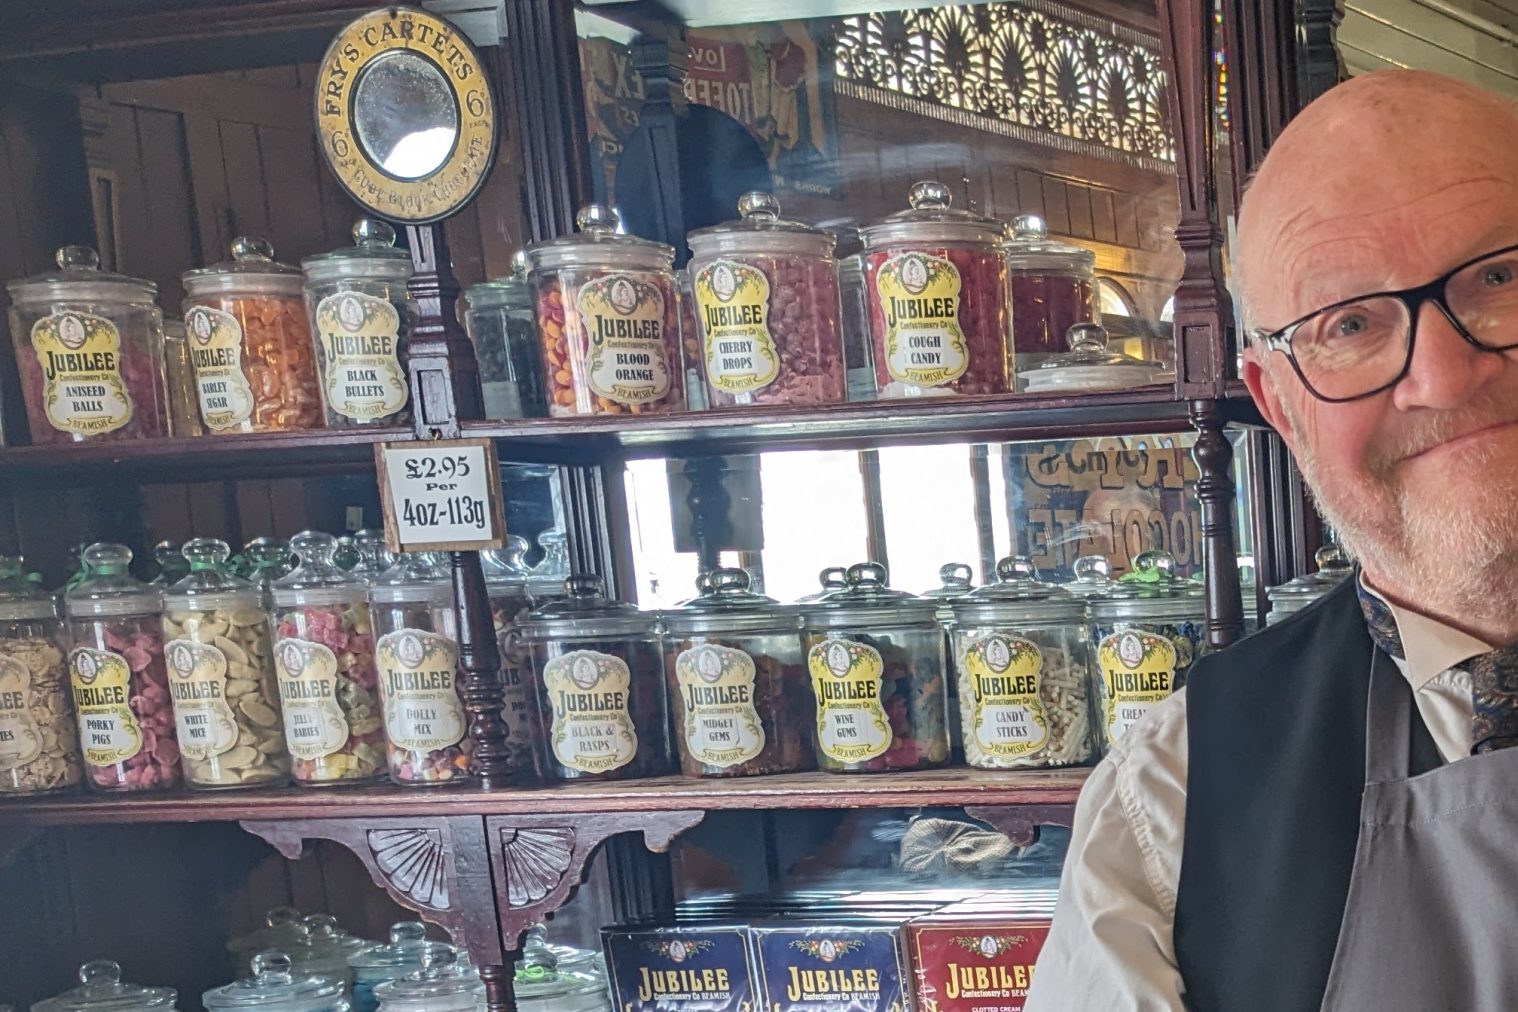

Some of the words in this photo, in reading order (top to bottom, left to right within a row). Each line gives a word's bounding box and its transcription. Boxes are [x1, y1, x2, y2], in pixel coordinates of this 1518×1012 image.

[326, 43, 360, 117] FRY'S
[364, 21, 473, 80] CARTETS
[888, 297, 955, 328] JUBILEE
[705, 304, 762, 336] JUBILEE
[592, 314, 660, 345] JUBILEE
[328, 333, 392, 362] JUBILEE
[719, 341, 753, 353] CHERRY
[909, 336, 941, 348] COUGH
[616, 353, 650, 365] BLOOD
[723, 357, 753, 370] DROPS
[910, 352, 941, 364] CANDY
[46, 351, 116, 380] JUBILEE
[347, 370, 377, 381] BLACK
[615, 368, 654, 381] ORANGE
[65, 385, 106, 397] ANISEED
[202, 382, 227, 394] BARLEY
[345, 385, 384, 397] BULLETS
[73, 401, 104, 412] BALLS
[405, 456, 470, 479] £2.95
[426, 482, 458, 491] Per
[403, 496, 486, 529] 4oz-113g
[387, 669, 450, 697] JUBILEE
[974, 674, 1036, 703] JUBILEE
[1107, 669, 1169, 699] JUBILEE
[687, 684, 749, 712] JUBILEE
[818, 678, 877, 707] JUBILEE
[556, 690, 623, 718] JUBILEE
[185, 715, 208, 725] WHITE
[406, 708, 437, 720] DOLLY
[835, 714, 854, 724] WINE
[995, 710, 1025, 723] CANDY
[87, 720, 114, 730] PORKY
[414, 724, 432, 735] MIX
[703, 719, 733, 728] MIDGET
[190, 728, 206, 738] MICE
[293, 727, 319, 737] BABIES
[572, 727, 602, 737] BLACK
[606, 726, 614, 736] &
[709, 732, 730, 742] GEMS
[837, 727, 857, 738] GUMS
[997, 726, 1028, 738] STICKS
[92, 734, 111, 744] PIGS
[579, 741, 610, 752] RASPS
[836, 748, 867, 757] BEAMISH
[994, 743, 1025, 754] BEAMISH
[639, 967, 730, 1002] JUBILEE
[787, 966, 880, 1002] JUBILEE
